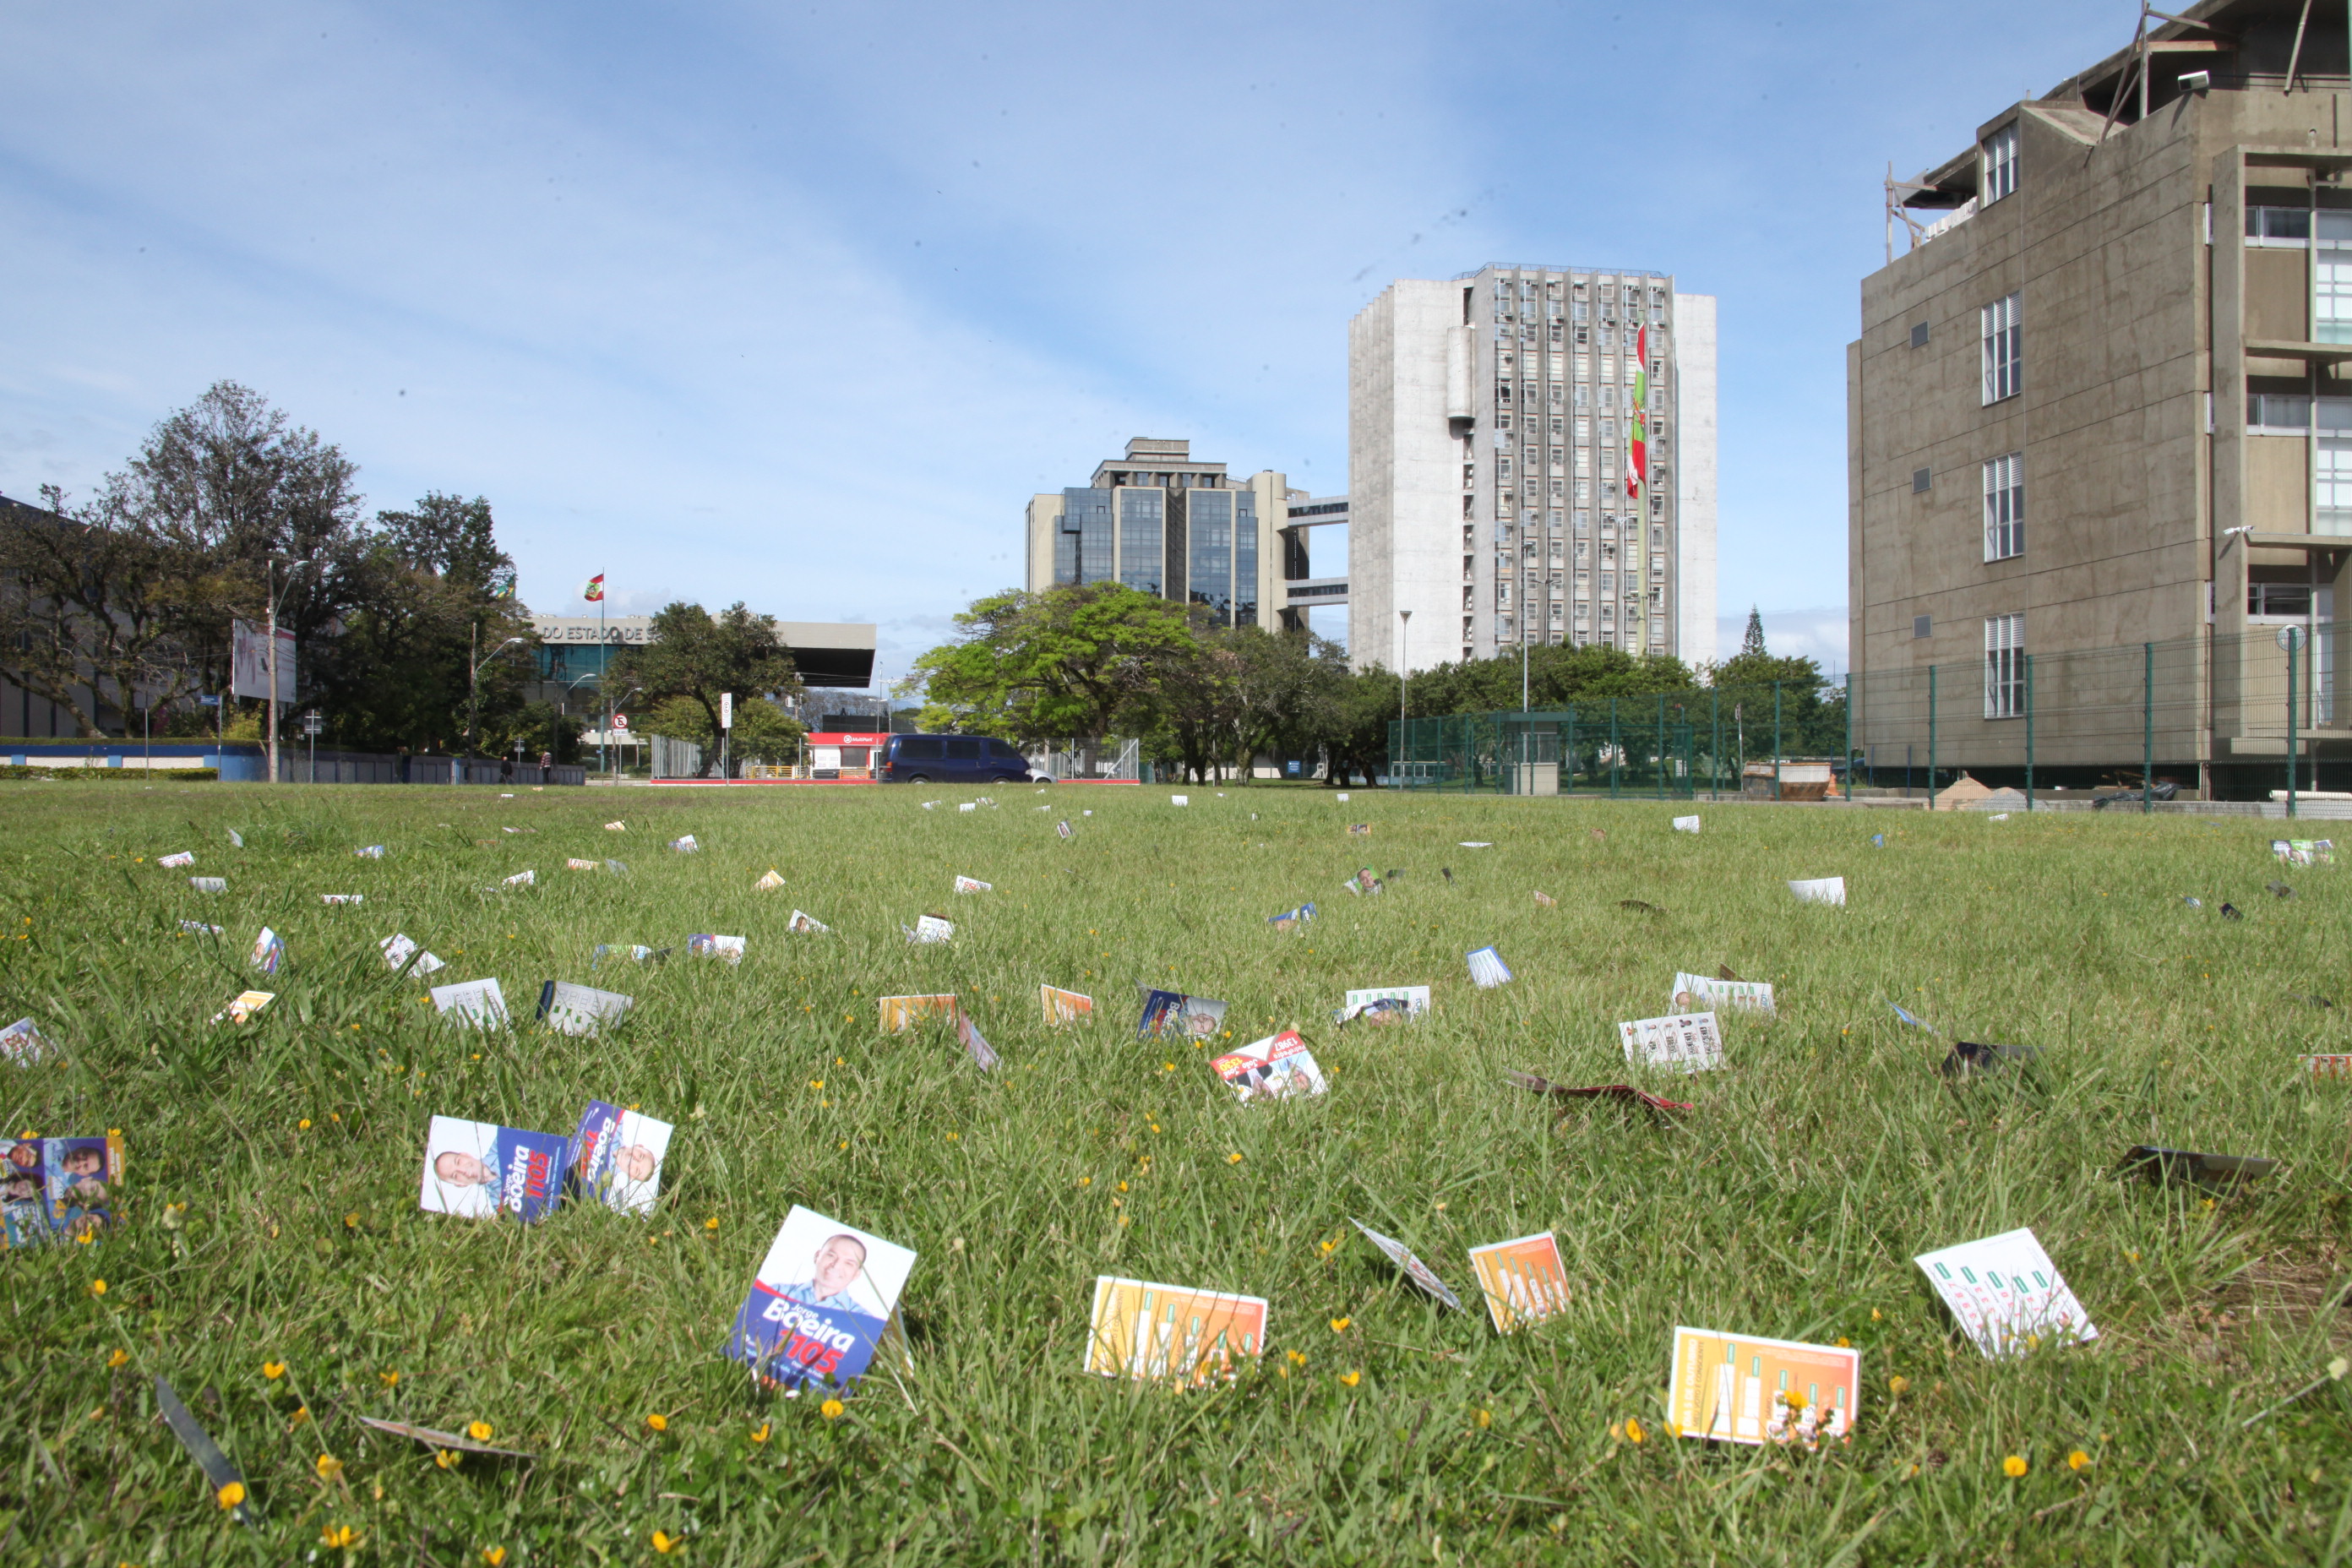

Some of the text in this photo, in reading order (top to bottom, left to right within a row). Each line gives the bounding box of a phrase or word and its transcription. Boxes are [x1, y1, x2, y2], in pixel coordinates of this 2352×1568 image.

[543, 627, 563, 640] DO
[567, 627, 621, 640] ESTADO
[625, 627, 643, 640] DE
[1274, 1037, 1298, 1051] 13987
[1219, 1057, 1244, 1071] 1330
[1223, 1059, 1258, 1078] João José
[525, 1151, 548, 1197] 1105
[53, 1199, 68, 1219] 45
[792, 1302, 819, 1320] Jorge
[763, 1298, 857, 1350] Boeira
[776, 1328, 843, 1373] 1105
[1685, 1338, 1697, 1386] OUTUBRO
[1685, 1387, 1694, 1401] DE
[1683, 1410, 1692, 1426] DIA
